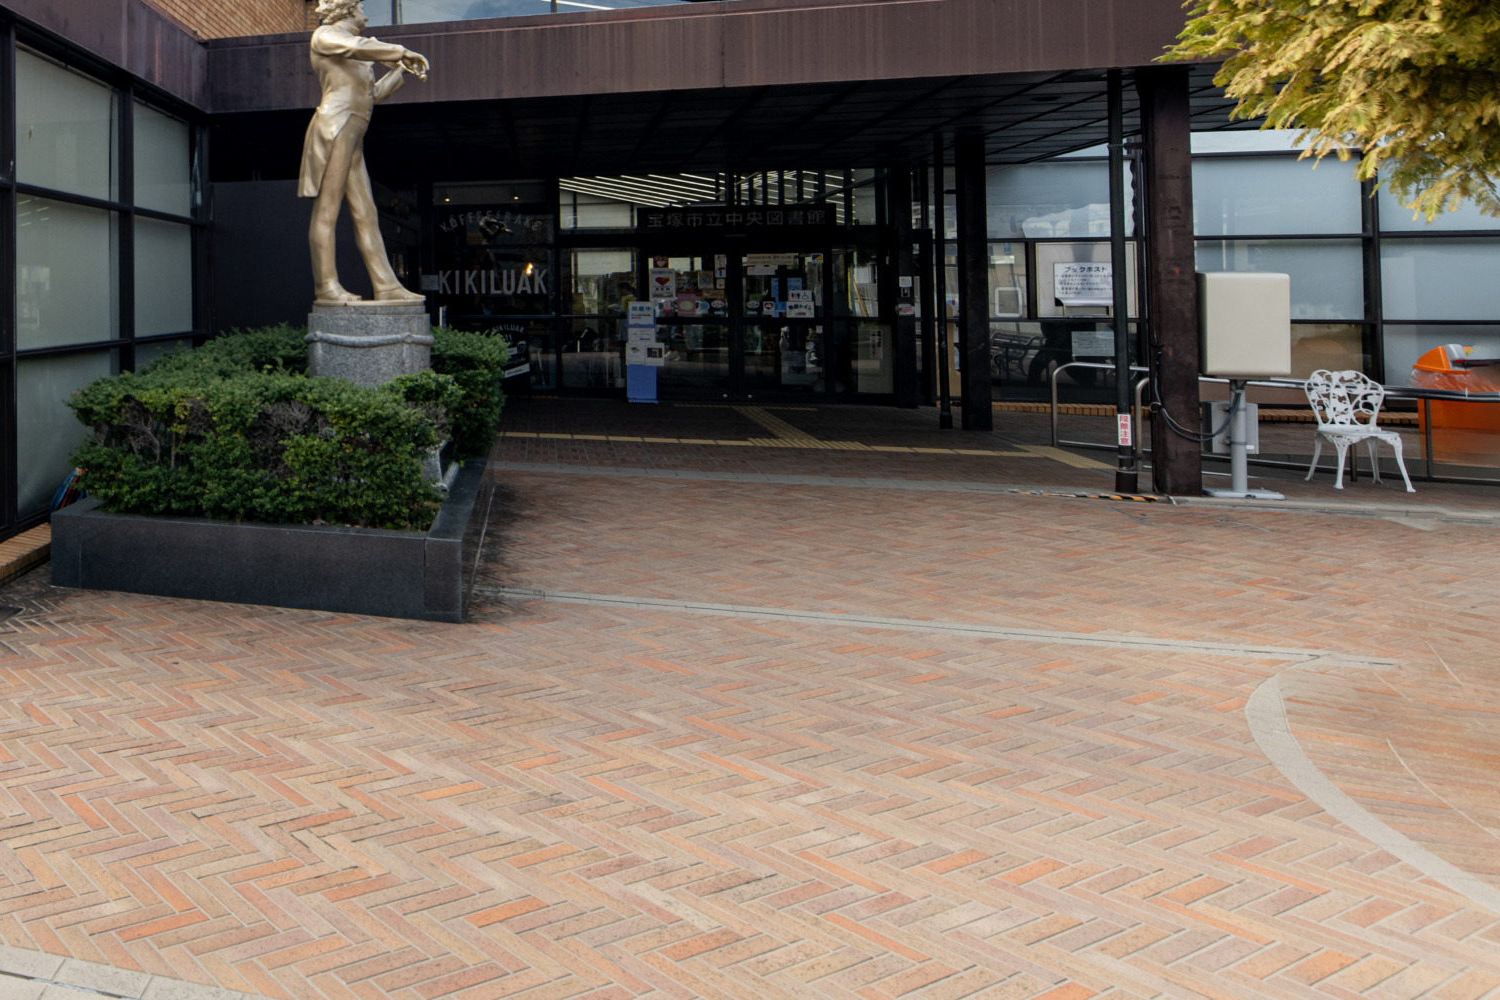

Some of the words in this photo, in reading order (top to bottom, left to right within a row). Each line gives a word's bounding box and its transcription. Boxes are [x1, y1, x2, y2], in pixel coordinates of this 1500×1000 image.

[646, 209, 827, 228] 宝塚市立中央図書館
[438, 269, 548, 295] KIKILUAK
